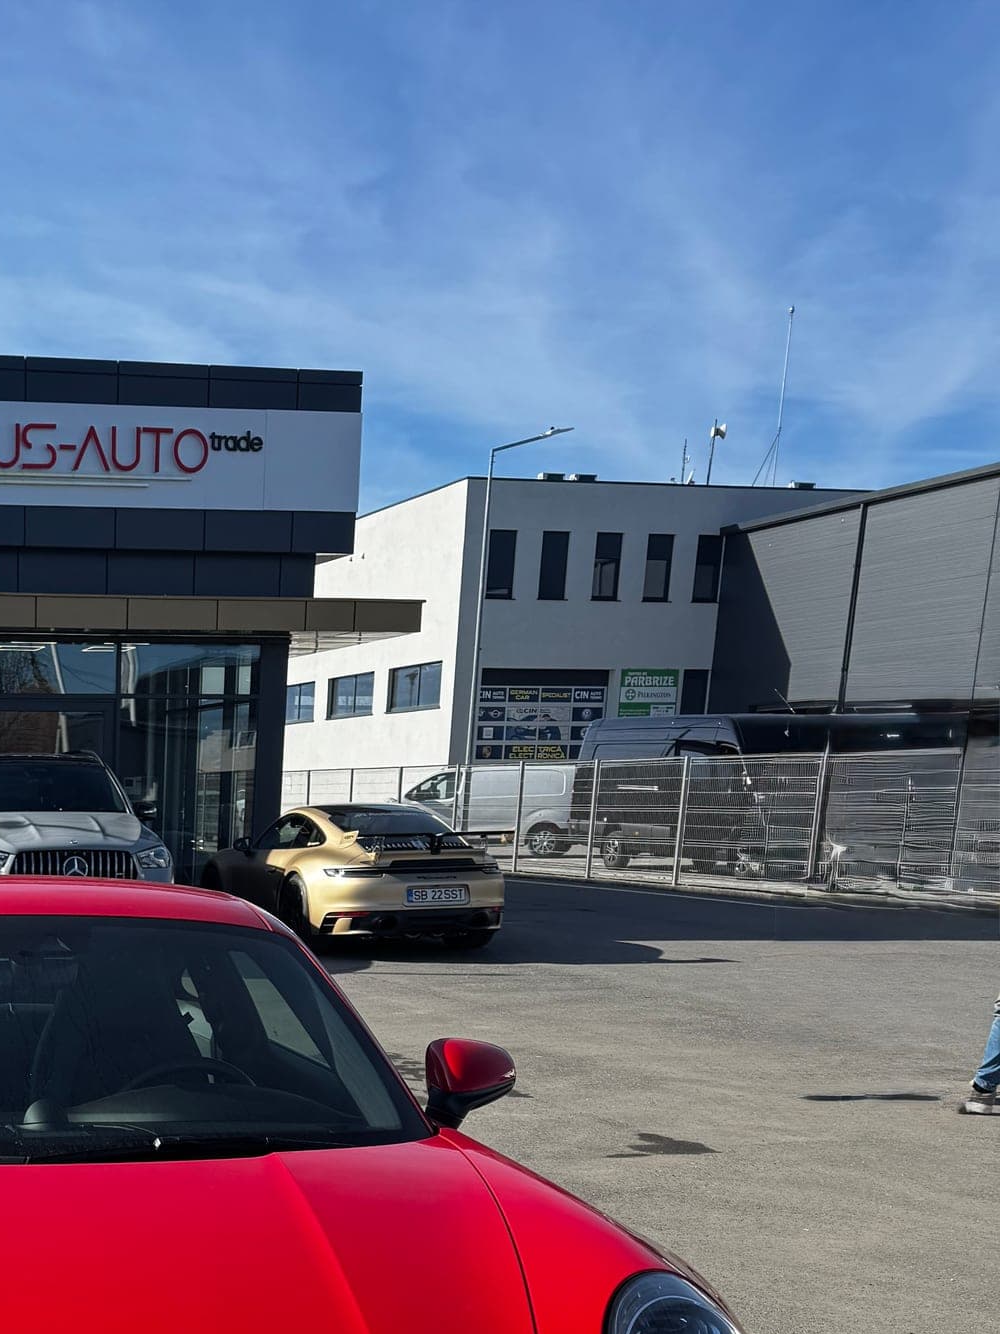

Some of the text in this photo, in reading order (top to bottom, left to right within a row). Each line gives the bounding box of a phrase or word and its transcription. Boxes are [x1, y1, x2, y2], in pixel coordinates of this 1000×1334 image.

[209, 431, 264, 453] trade
[624, 676, 675, 686] PARBRIZE
[575, 691, 589, 699] CIN
[414, 890, 428, 900] SB
